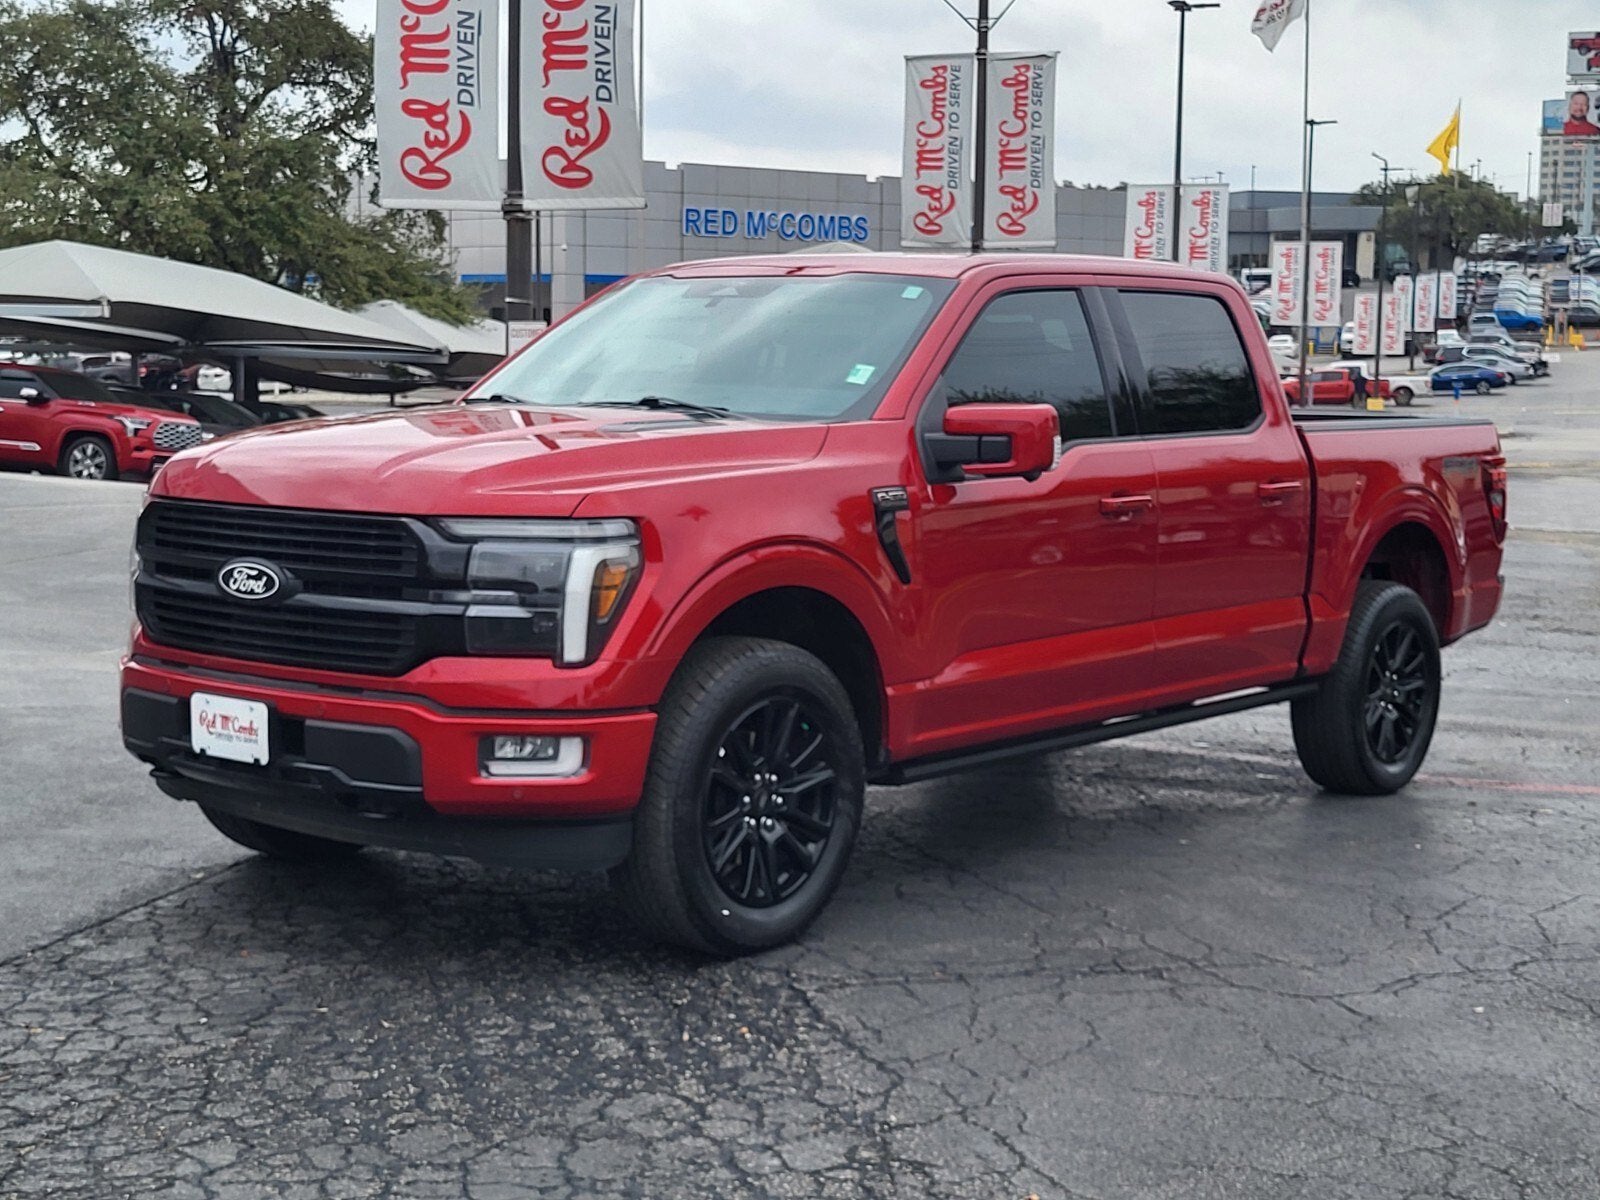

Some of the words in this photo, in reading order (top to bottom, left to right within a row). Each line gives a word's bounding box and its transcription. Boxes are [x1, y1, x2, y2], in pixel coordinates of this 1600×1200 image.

[456, 10, 476, 107] DRIVEN
[541, 0, 589, 88] Mc
[593, 4, 613, 103] DRIVEN
[950, 64, 962, 108] SERVE
[1032, 64, 1044, 108] SERVE
[400, 97, 472, 190] Red
[542, 95, 611, 189] Red
[916, 65, 948, 180] McCombs
[948, 111, 961, 133] TO
[998, 63, 1032, 181] McCombs
[1030, 110, 1043, 133] TO
[947, 136, 961, 189] DRIVEN
[1030, 135, 1043, 189] DRIVEN
[684, 207, 739, 236] RED
[746, 211, 869, 242] McCOMBS
[913, 185, 956, 235] Red
[996, 184, 1039, 236] Red
[1188, 190, 1211, 267] McCombs
[229, 567, 267, 594] Ford
[199, 709, 217, 735] Red
